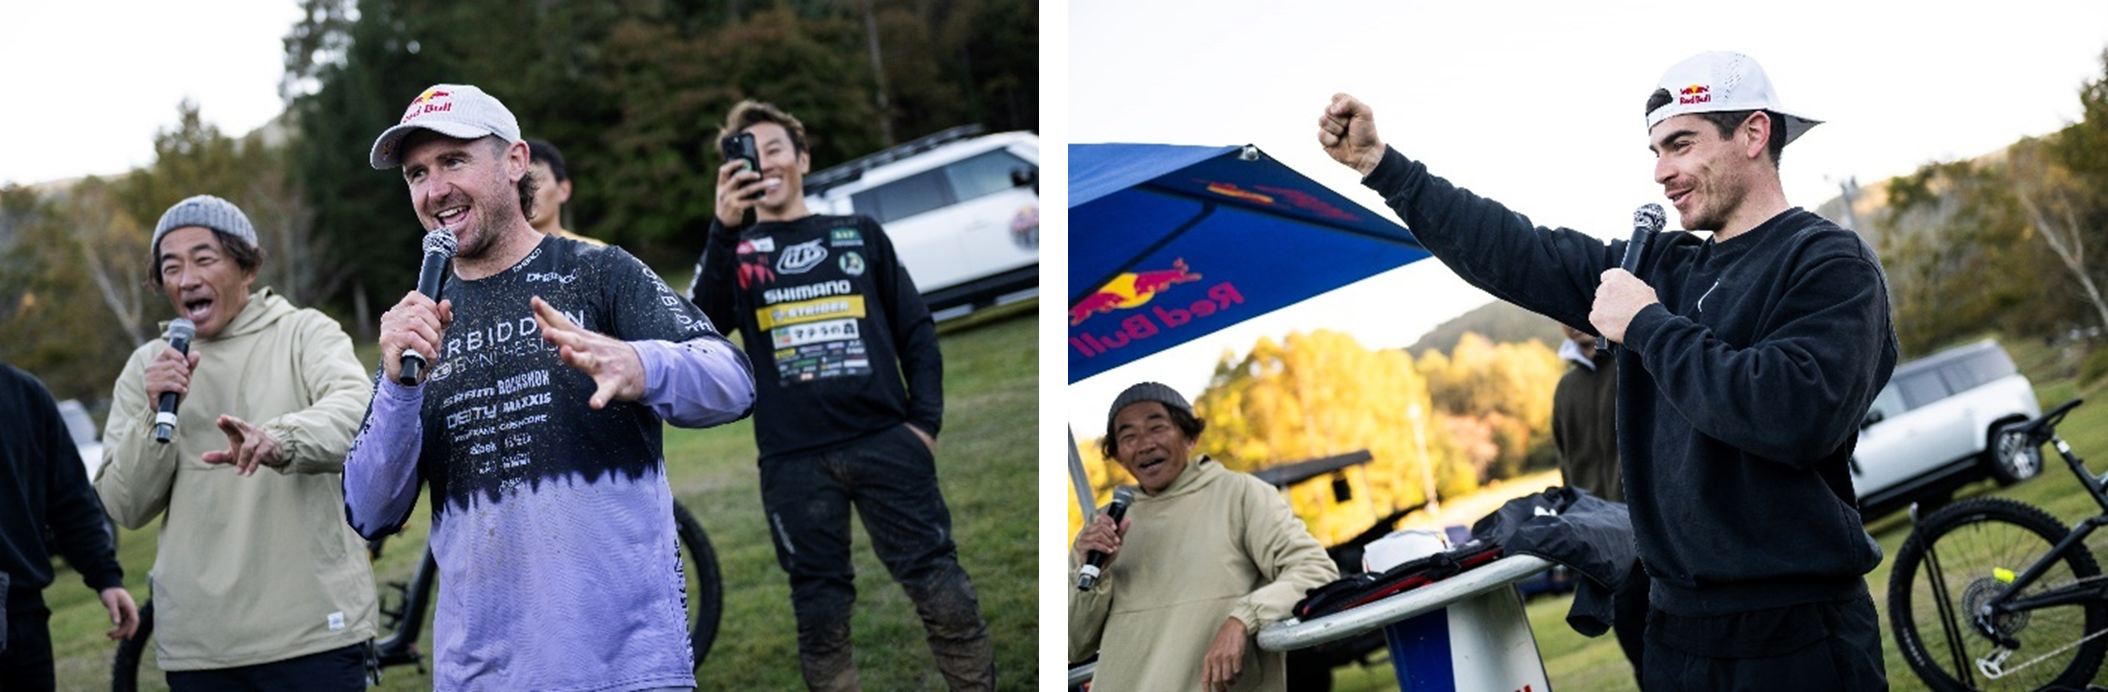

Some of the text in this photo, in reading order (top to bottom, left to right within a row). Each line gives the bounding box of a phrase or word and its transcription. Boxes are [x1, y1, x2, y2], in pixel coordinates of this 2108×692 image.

[424, 102, 452, 113] Bull
[1680, 94, 1711, 105] Red Bull
[764, 280, 851, 304] SHIMANO
[446, 392, 552, 429] DEITY MAXXIS
